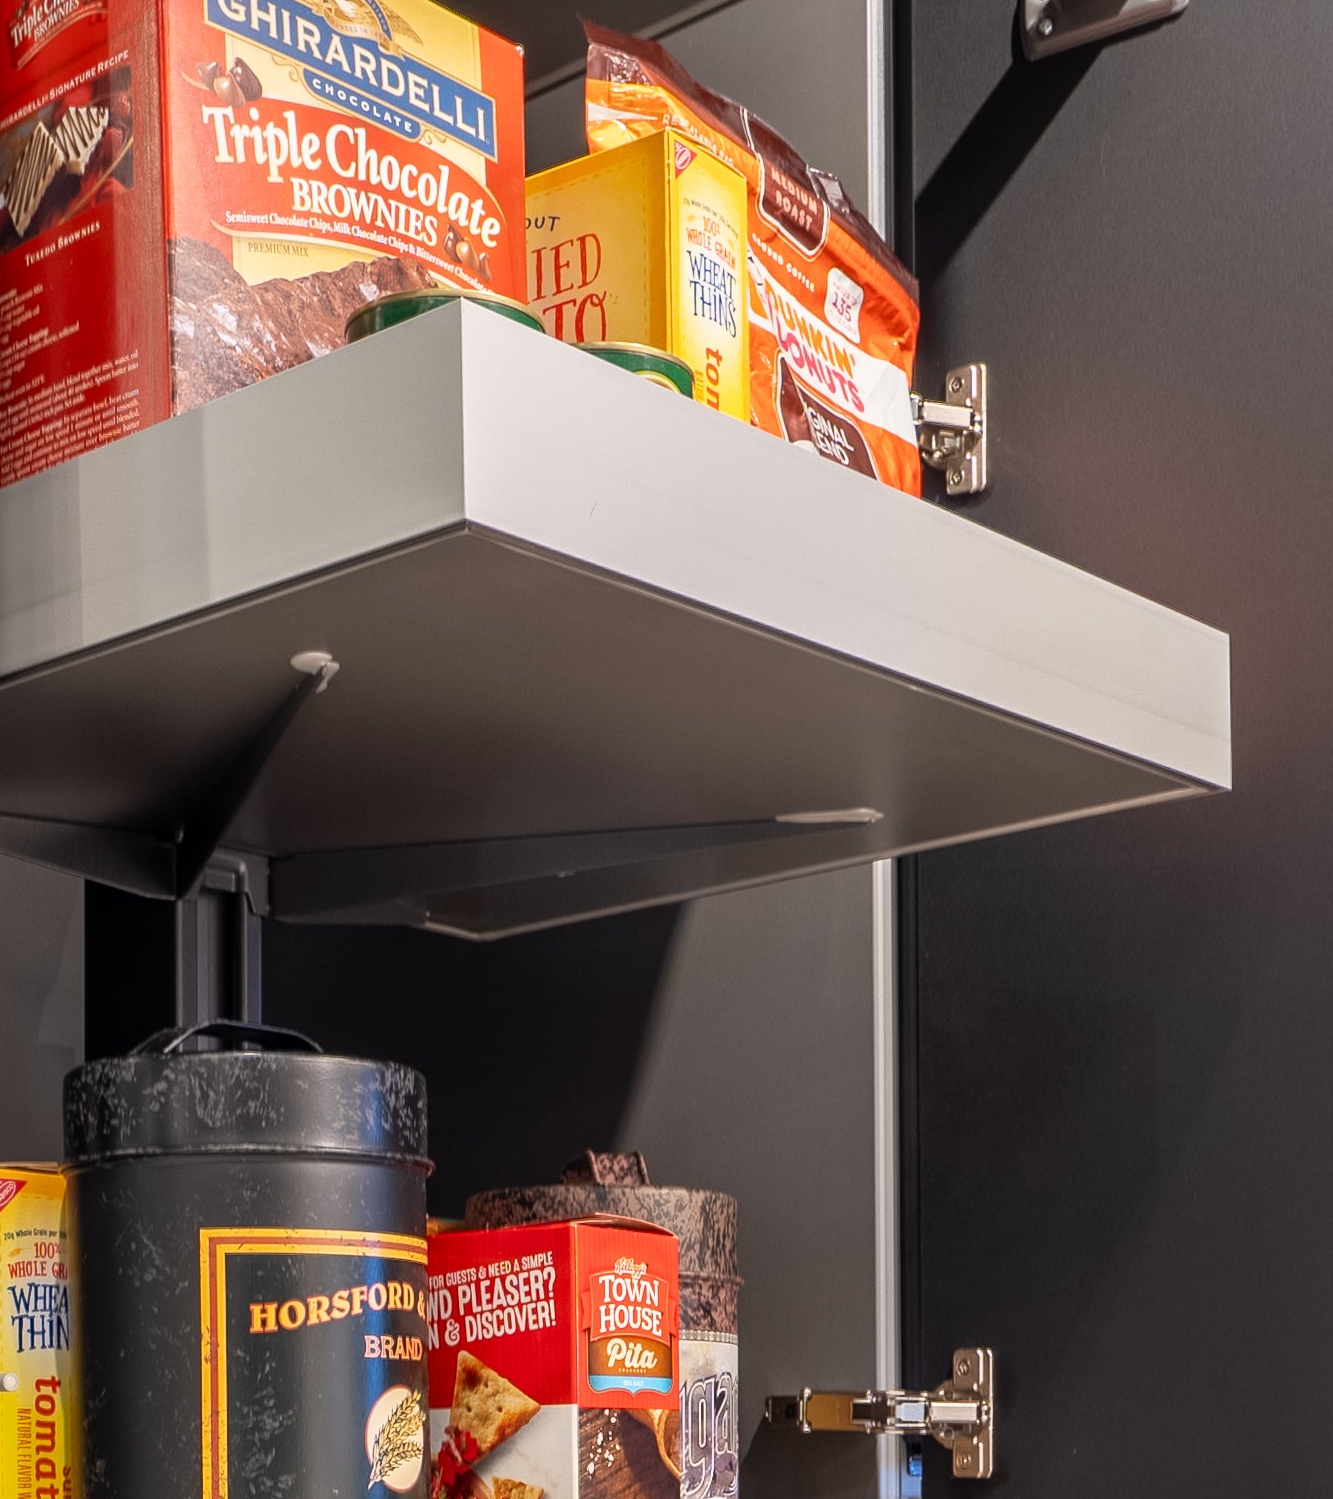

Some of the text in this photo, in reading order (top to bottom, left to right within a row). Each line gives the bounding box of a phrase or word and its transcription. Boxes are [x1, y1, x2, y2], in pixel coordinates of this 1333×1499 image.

[11, 4, 44, 48] Triple
[313, 78, 412, 133] CHOCOLATE
[202, 105, 501, 248] Triple Chocolate
[770, 166, 819, 216] MEDIUM
[290, 177, 438, 247] BROWNIES
[775, 189, 812, 231] ROAST
[225, 210, 268, 225] Semisweet
[269, 212, 308, 228] Chocolate
[309, 216, 332, 234] Chips,
[333, 220, 351, 235] Milk
[351, 225, 387, 245] Chocolate
[388, 234, 408, 253] Chips
[416, 245, 454, 273] Bittersweet
[454, 266, 493, 293] Chocolat
[248, 242, 309, 257] PREMIUM MIX
[687, 250, 737, 299] WHEAT
[429, 1251, 553, 1290] FOR GUESTS & NEED A SIMPLE
[457, 1266, 556, 1316] PLEASER?
[599, 1274, 659, 1306] TOWN
[7, 1282, 68, 1314] WHEA
[250, 1281, 415, 1334] HORSFORD
[444, 1319, 460, 1347] &
[466, 1300, 557, 1343] DISCOVER!
[599, 1305, 662, 1337] HOUSE
[364, 1335, 423, 1361] BRAND
[606, 1338, 657, 1369] Pita
